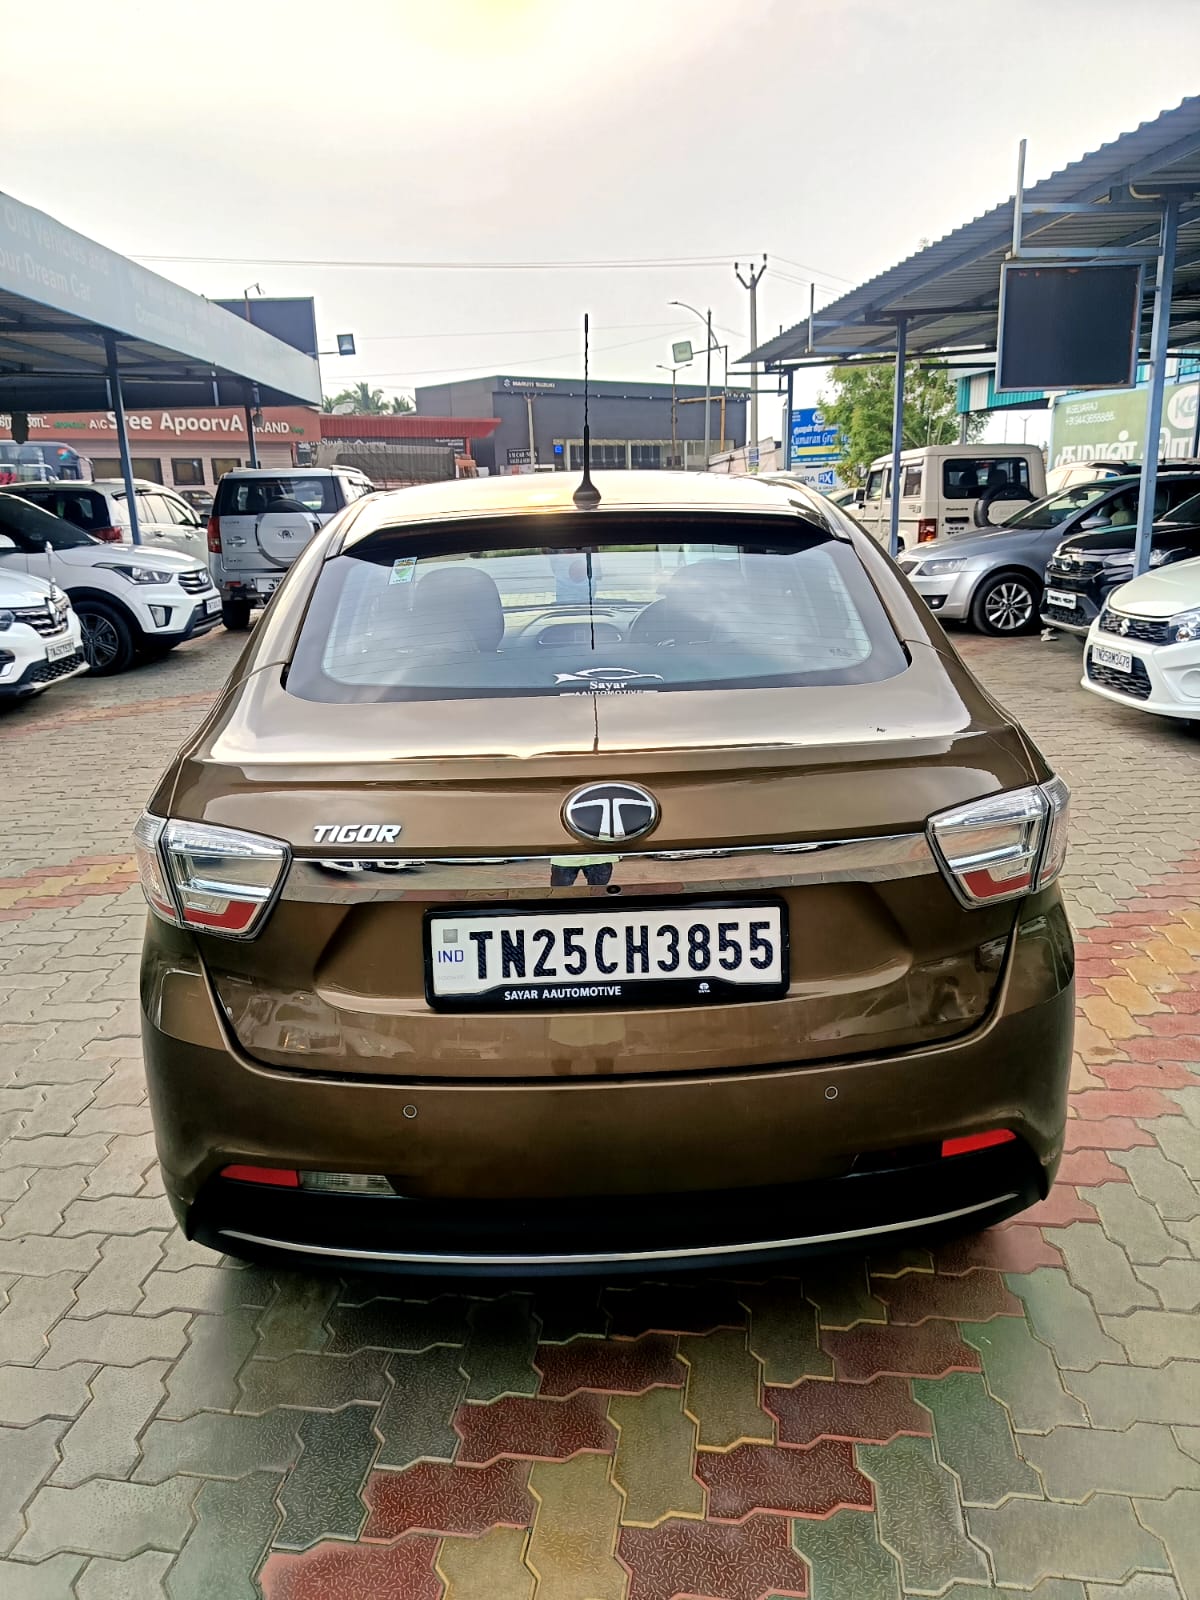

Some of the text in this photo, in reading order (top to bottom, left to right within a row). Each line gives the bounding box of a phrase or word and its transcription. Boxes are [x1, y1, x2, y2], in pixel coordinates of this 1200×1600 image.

[160, 412, 244, 435] ApoorvA
[589, 681, 628, 690] Sayar
[313, 824, 402, 844] TIGOR
[438, 949, 464, 963] IND
[469, 921, 773, 979] TN25CH3855
[504, 985, 622, 1001] SAYAR AAUTOMOTIVE
